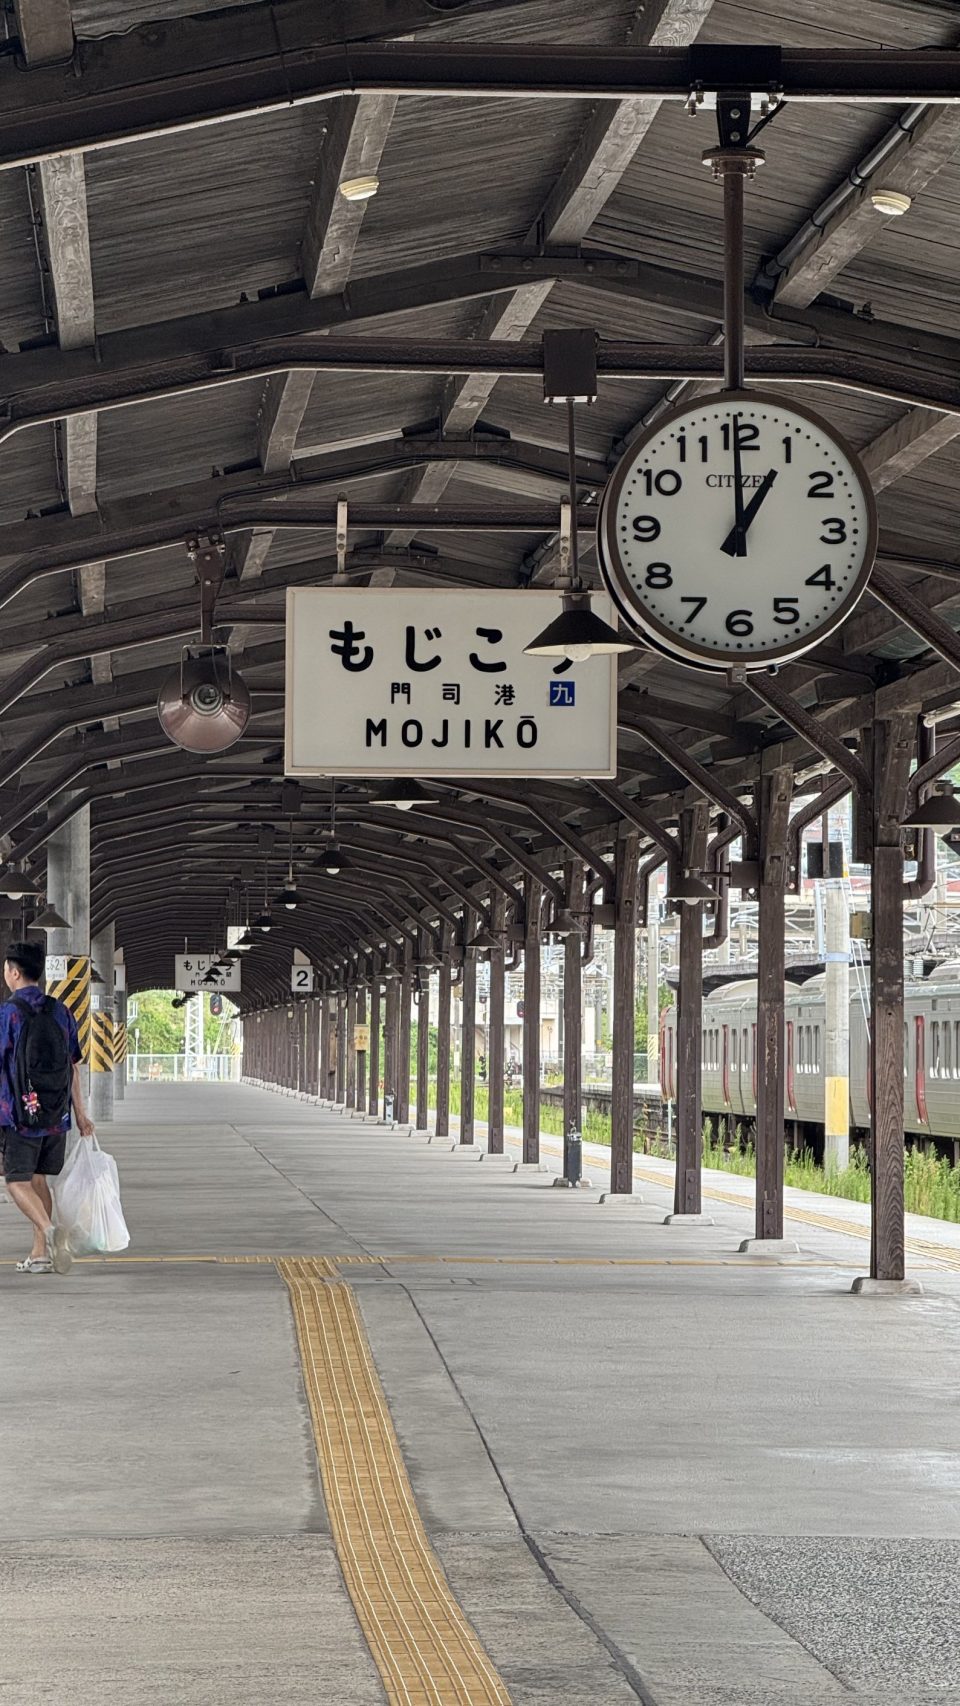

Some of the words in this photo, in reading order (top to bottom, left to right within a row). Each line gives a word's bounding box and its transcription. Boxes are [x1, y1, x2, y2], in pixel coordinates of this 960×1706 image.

[677, 435, 708, 463] 11
[720, 423, 760, 451] 12
[782, 436, 792, 463] 1
[643, 468, 682, 496] 10
[705, 474, 774, 488] CITZE
[807, 471, 835, 498] 2
[632, 515, 661, 542] 9
[819, 518, 847, 544] 3
[645, 562, 673, 589] 8
[805, 564, 836, 591] 4
[681, 597, 707, 624] 7
[725, 610, 754, 637] 6
[773, 597, 800, 625] 5
[391, 682, 516, 706] 門司港
[551, 684, 574, 705] 九
[366, 715, 538, 748] MOJIKŌ
[296, 970, 309, 986] 2
